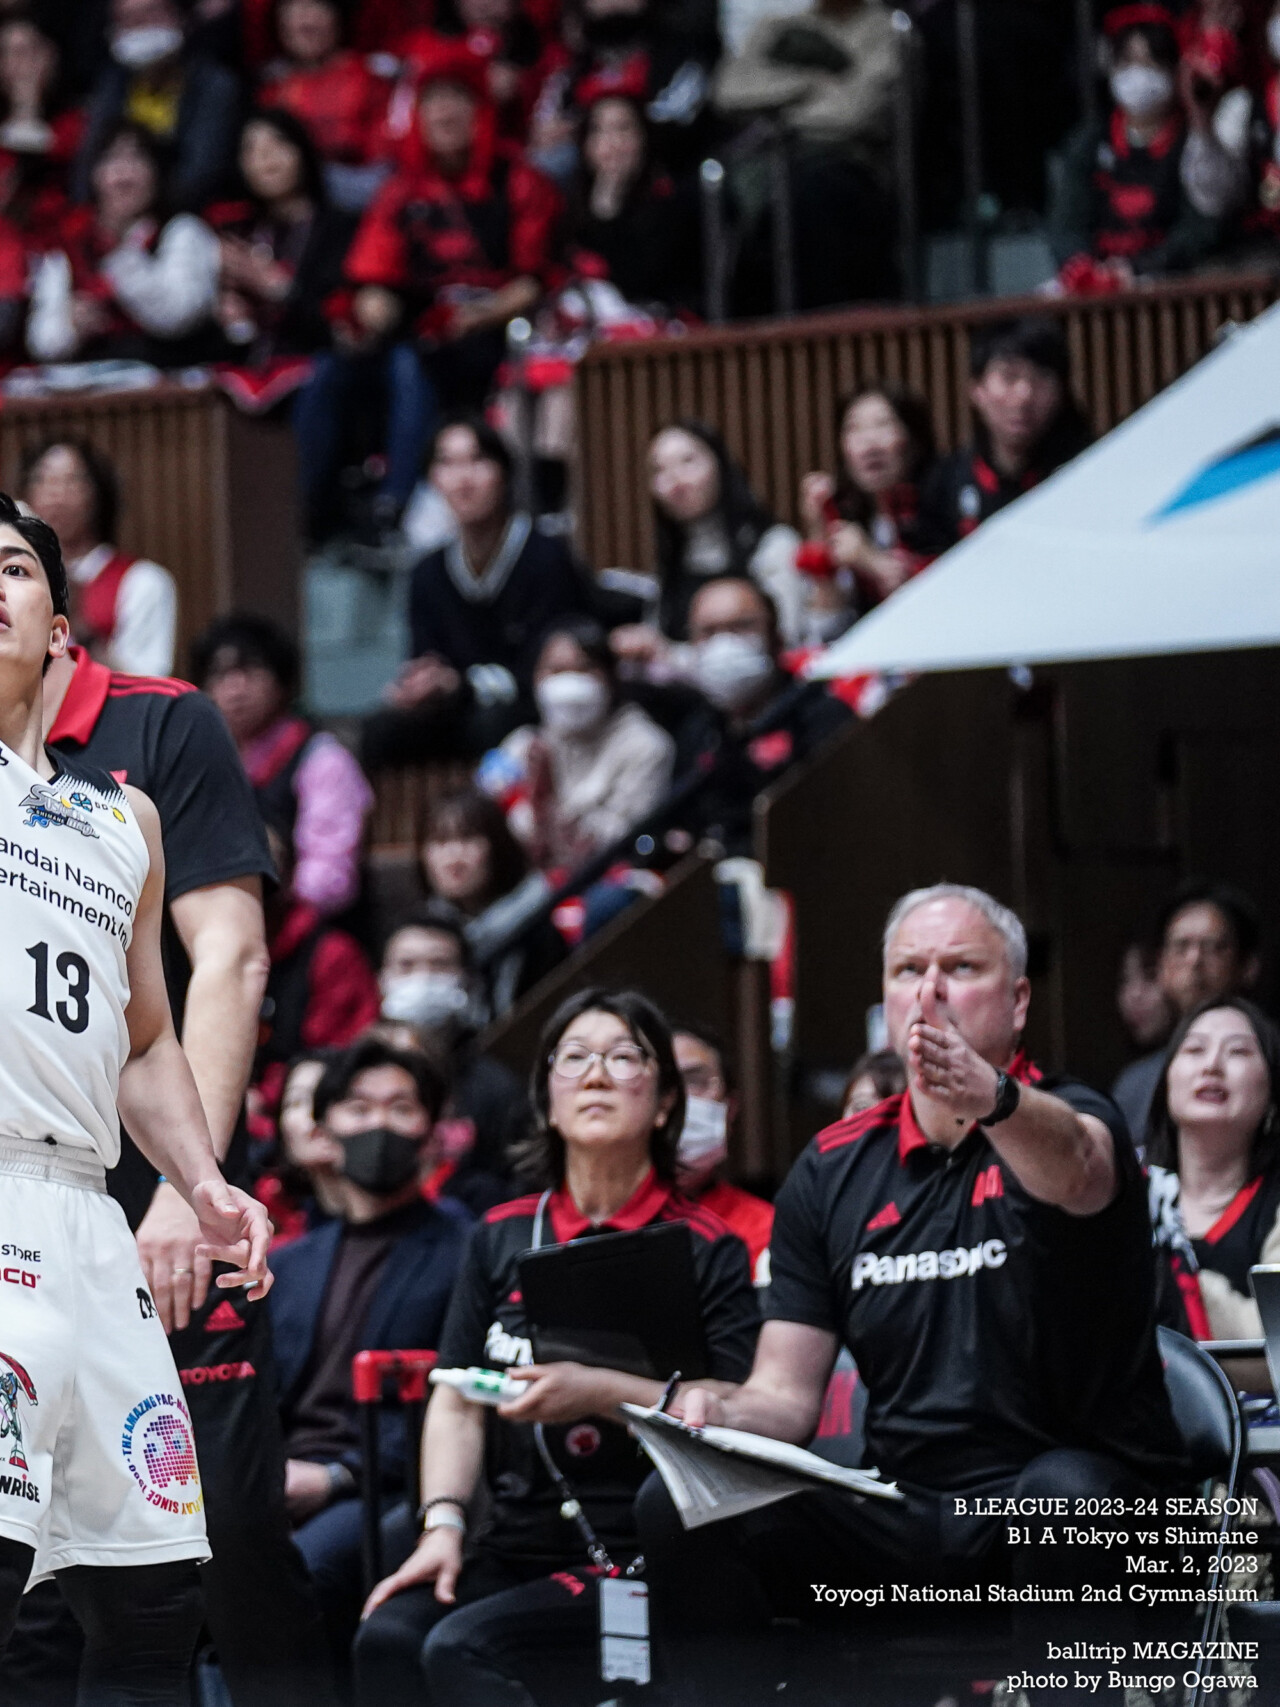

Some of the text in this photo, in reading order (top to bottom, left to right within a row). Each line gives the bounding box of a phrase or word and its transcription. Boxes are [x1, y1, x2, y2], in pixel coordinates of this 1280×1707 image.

[64, 862, 133, 917] Namco
[24, 940, 91, 1035] 13
[124, 1395, 158, 1434] AMAZNG
[145, 1489, 180, 1515] SINCE
